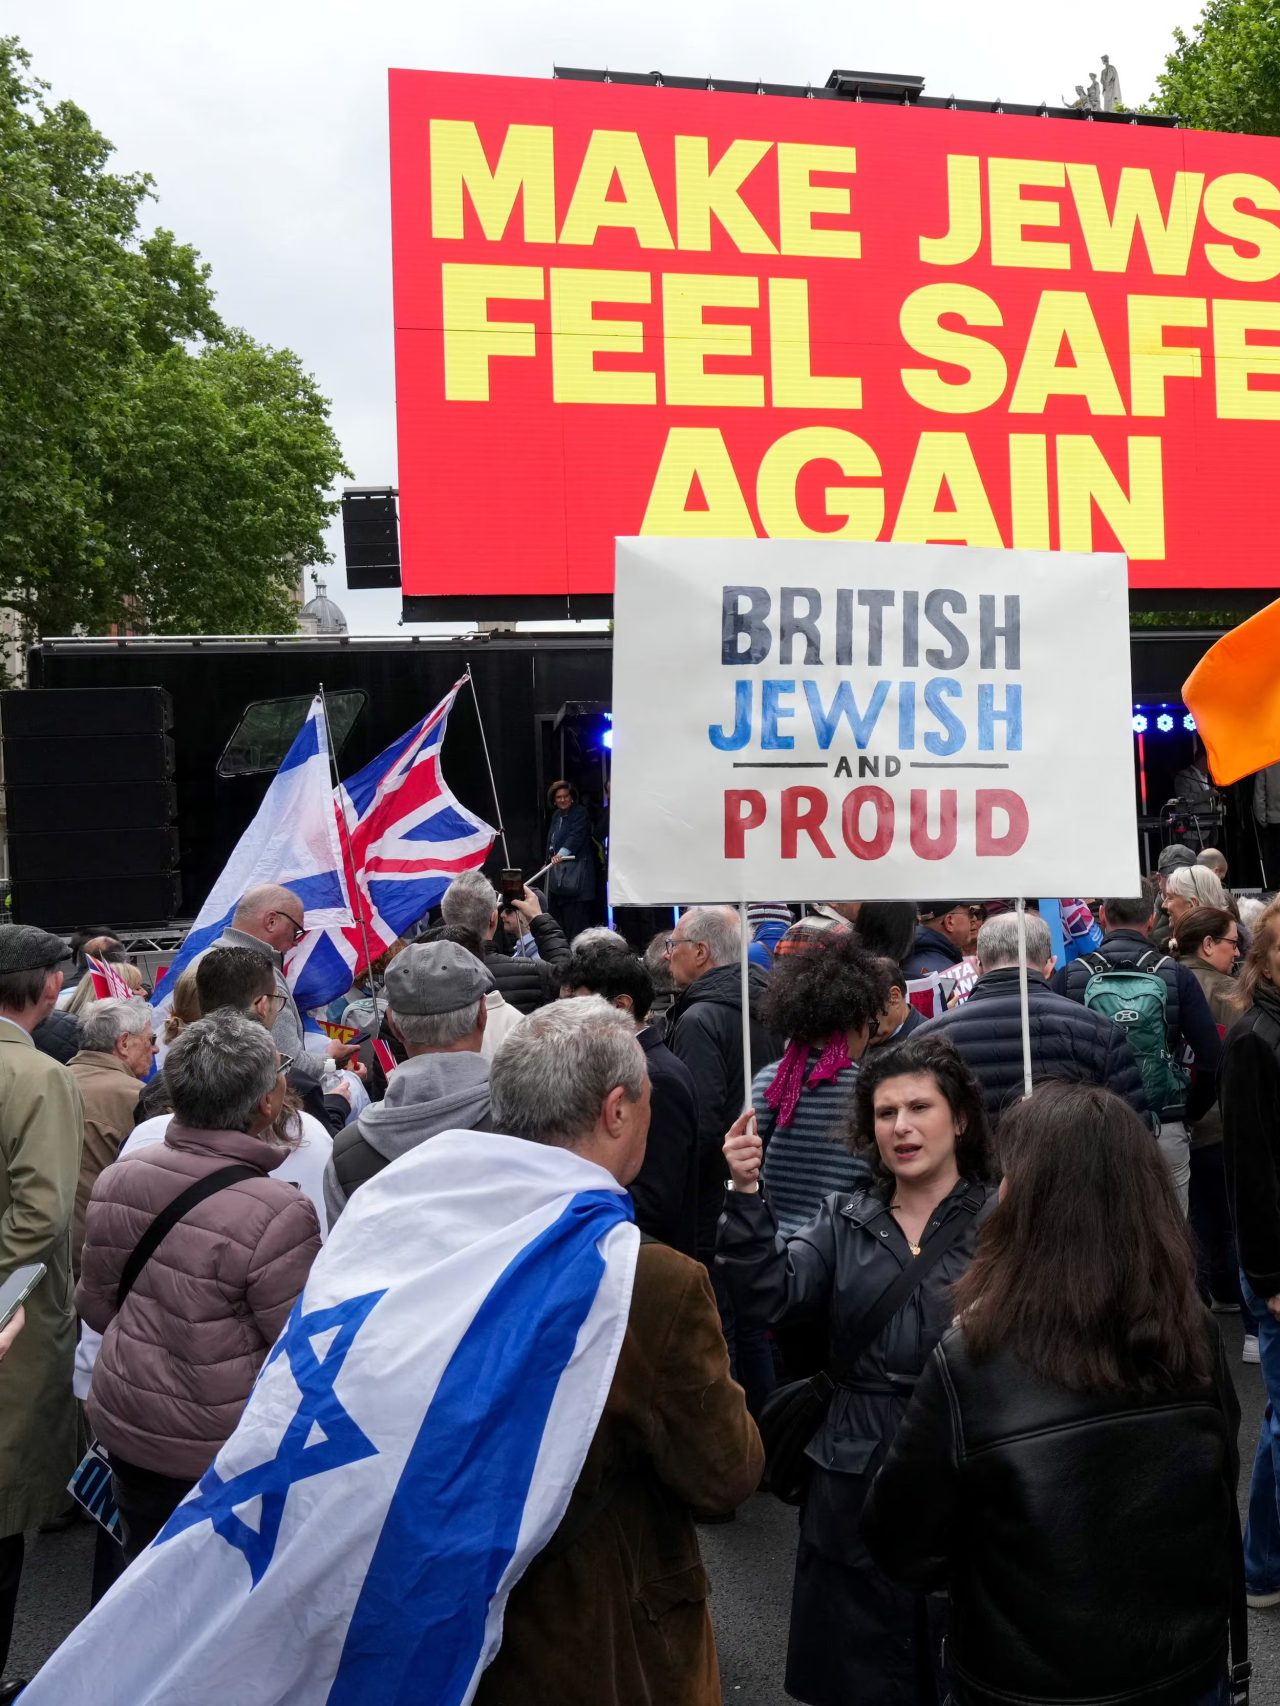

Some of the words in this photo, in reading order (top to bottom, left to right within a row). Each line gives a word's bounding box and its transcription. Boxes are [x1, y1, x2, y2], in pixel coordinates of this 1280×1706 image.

[429, 119, 861, 259] MAKE
[442, 263, 863, 409] FEEL
[638, 426, 1165, 560] AGAIN
[721, 586, 1021, 670] BRITISH
[708, 677, 1022, 756] JEWISH
[834, 756, 901, 777] AND
[724, 785, 1029, 861] PROUD
